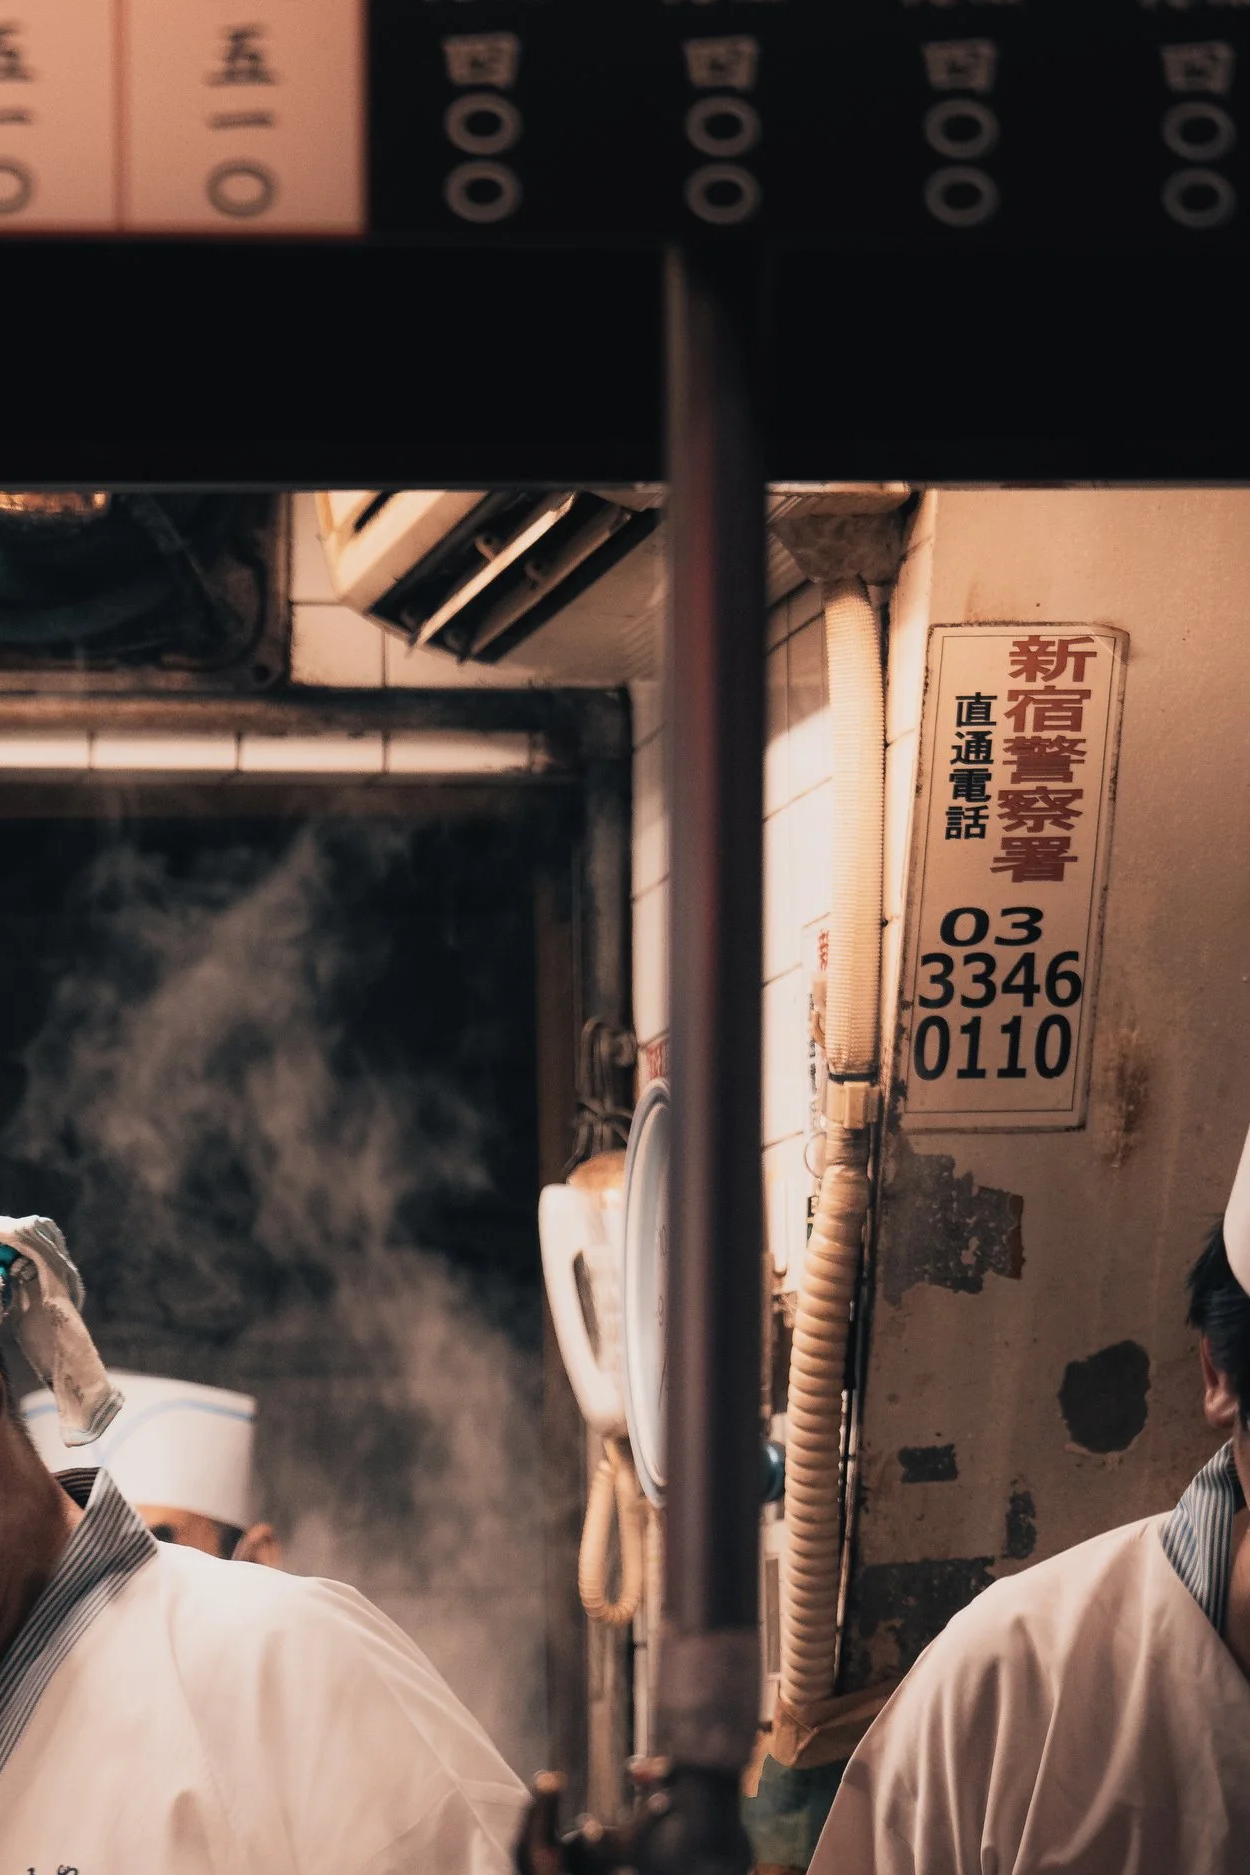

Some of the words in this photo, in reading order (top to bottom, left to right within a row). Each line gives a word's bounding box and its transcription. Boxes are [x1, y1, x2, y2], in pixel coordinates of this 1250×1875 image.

[945, 692, 998, 841] 直通電話
[990, 634, 1098, 884] 新宿警察署
[939, 906, 1044, 948] 03
[917, 951, 1082, 1010] 3346
[913, 1014, 1073, 1082] 0110
